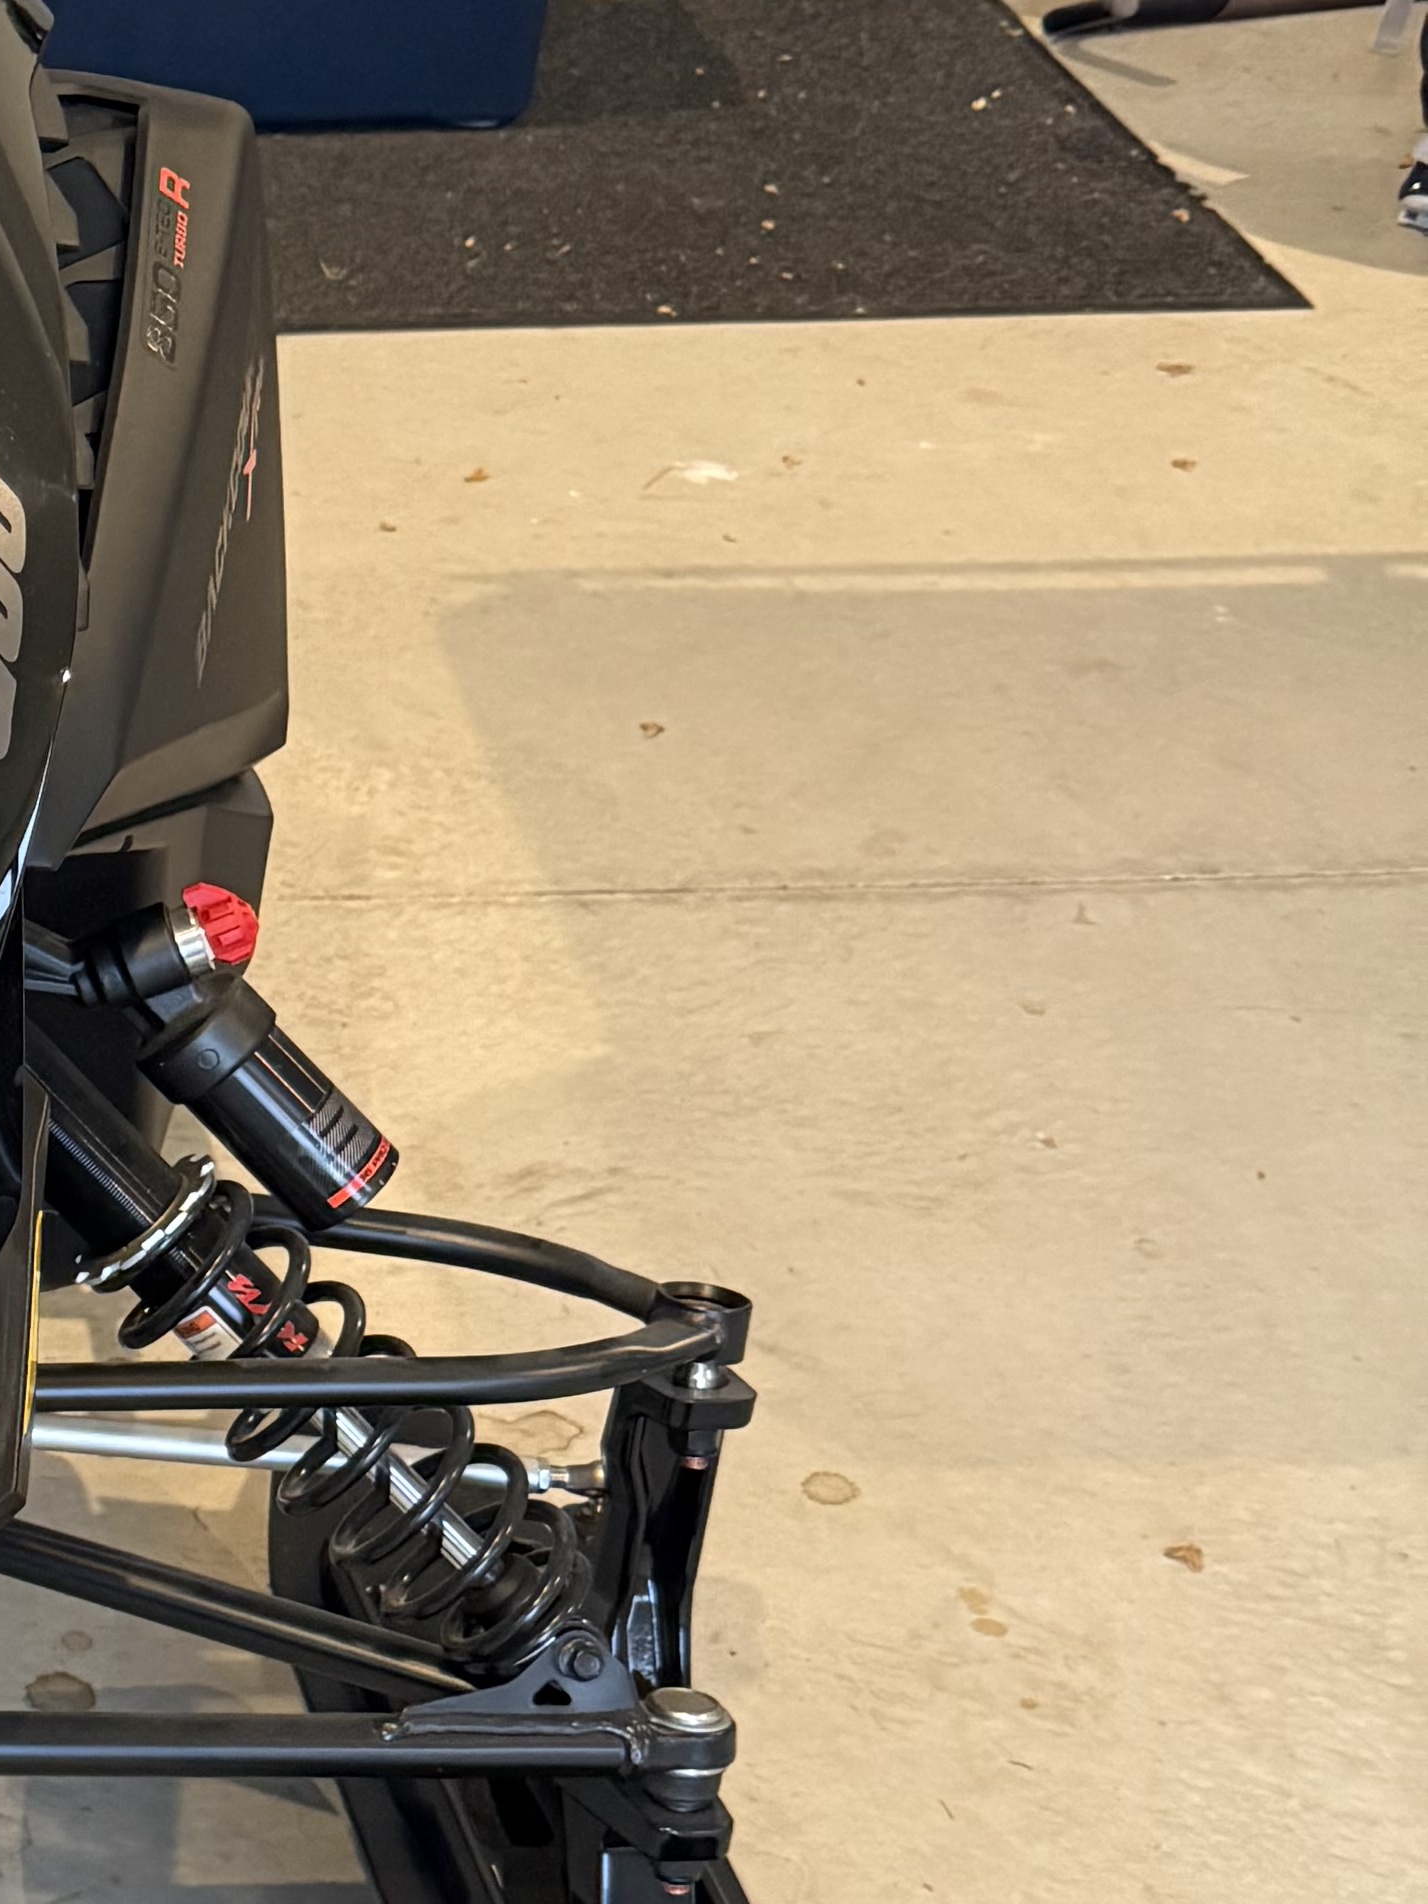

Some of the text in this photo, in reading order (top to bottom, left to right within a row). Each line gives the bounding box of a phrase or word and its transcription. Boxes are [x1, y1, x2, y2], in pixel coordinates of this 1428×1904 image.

[158, 166, 191, 269] TURBO R
[145, 260, 182, 366] 850
